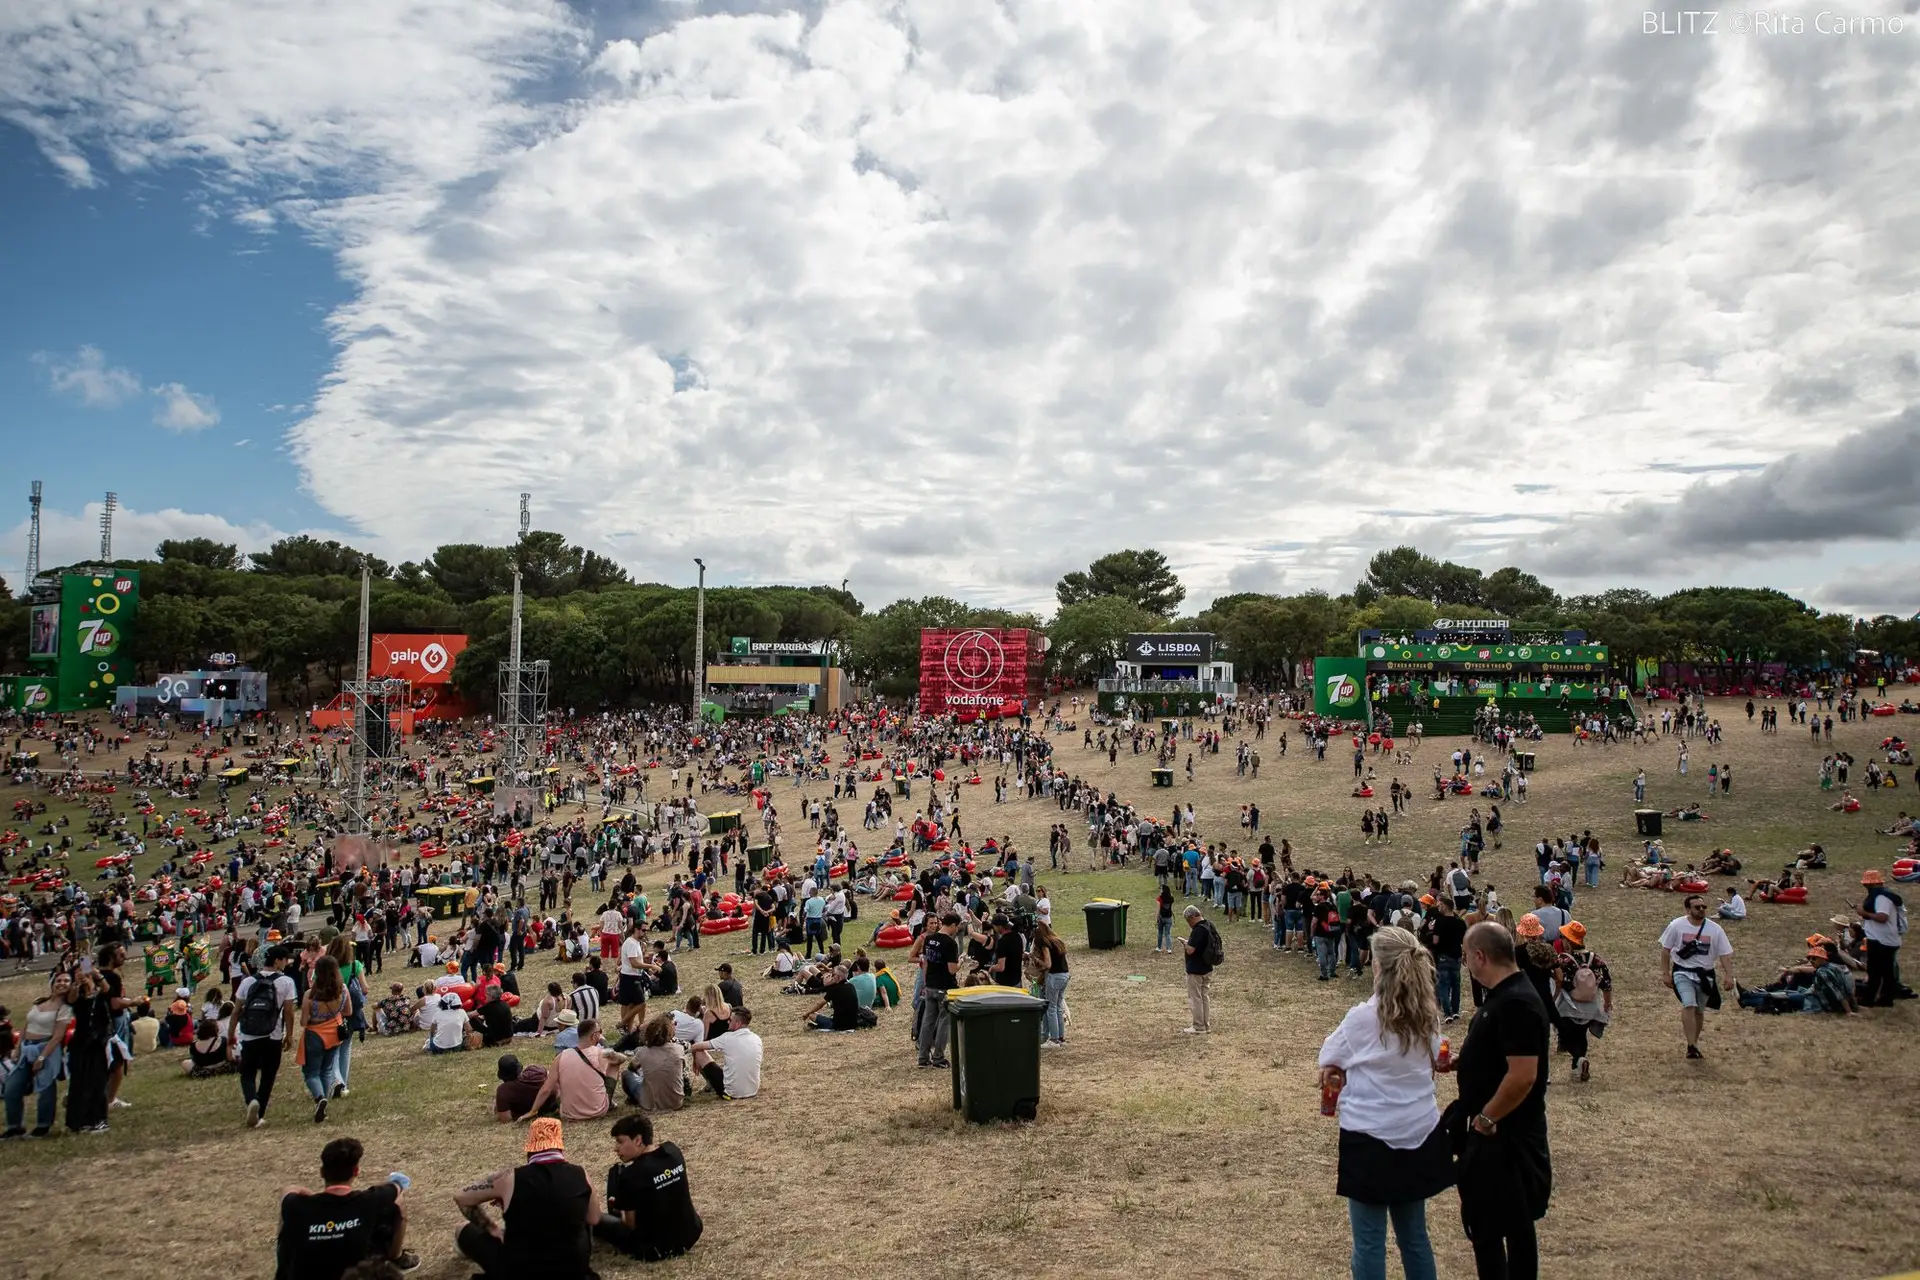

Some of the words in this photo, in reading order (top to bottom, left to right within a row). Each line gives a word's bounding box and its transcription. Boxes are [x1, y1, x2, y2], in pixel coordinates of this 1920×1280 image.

[1456, 619, 1509, 628] HYUNDAI
[752, 643, 772, 651] BNP
[773, 642, 813, 651] PARIBAS
[1158, 643, 1201, 652] LISBOA
[390, 648, 420, 664] galp
[945, 694, 1004, 706] vodafone
